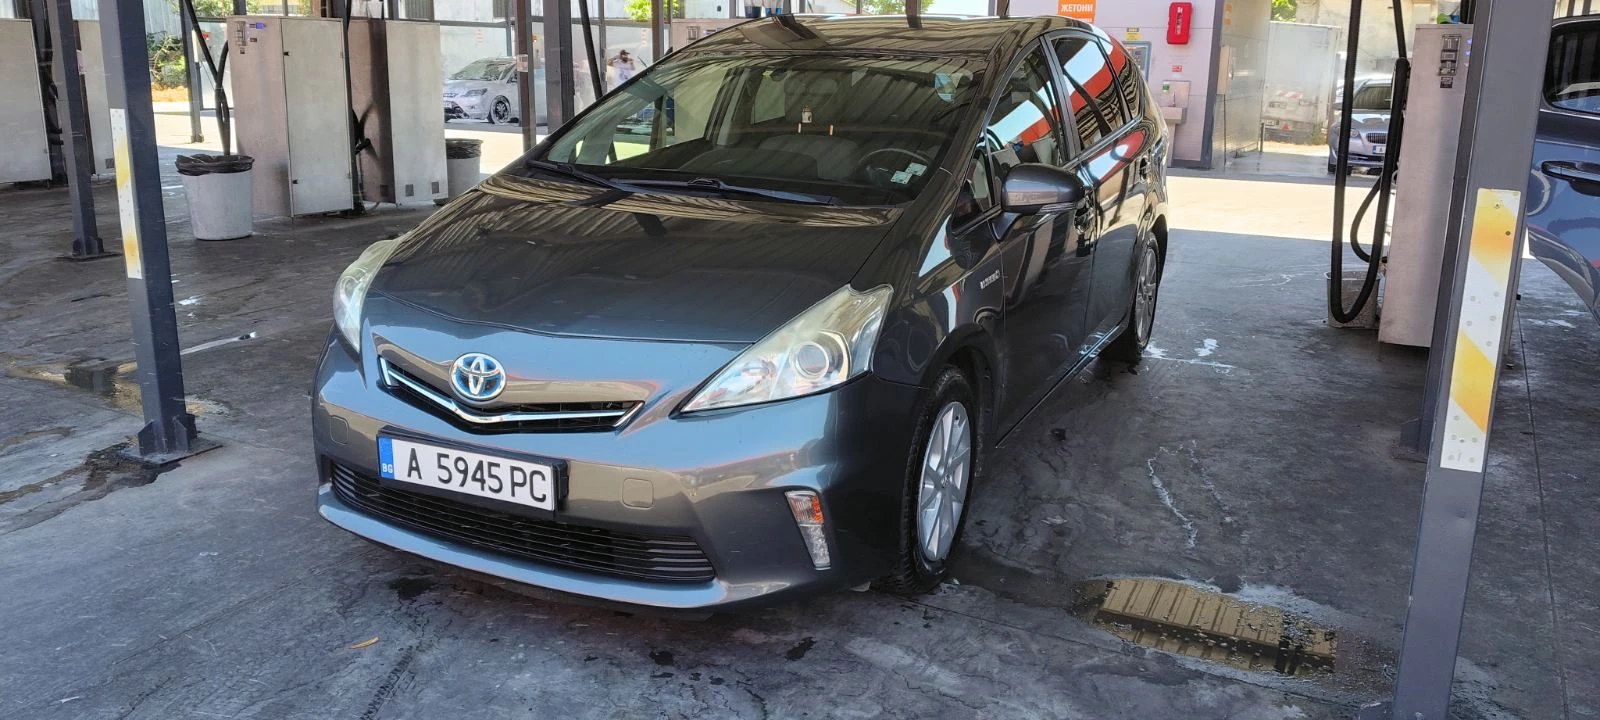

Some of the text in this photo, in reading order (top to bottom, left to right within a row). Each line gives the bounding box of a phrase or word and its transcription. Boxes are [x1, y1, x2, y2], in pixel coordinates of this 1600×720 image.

[1061, 4, 1093, 13] ЖЕТОНИ
[382, 463, 393, 473] BG
[407, 448, 547, 503] A 5945 PC
